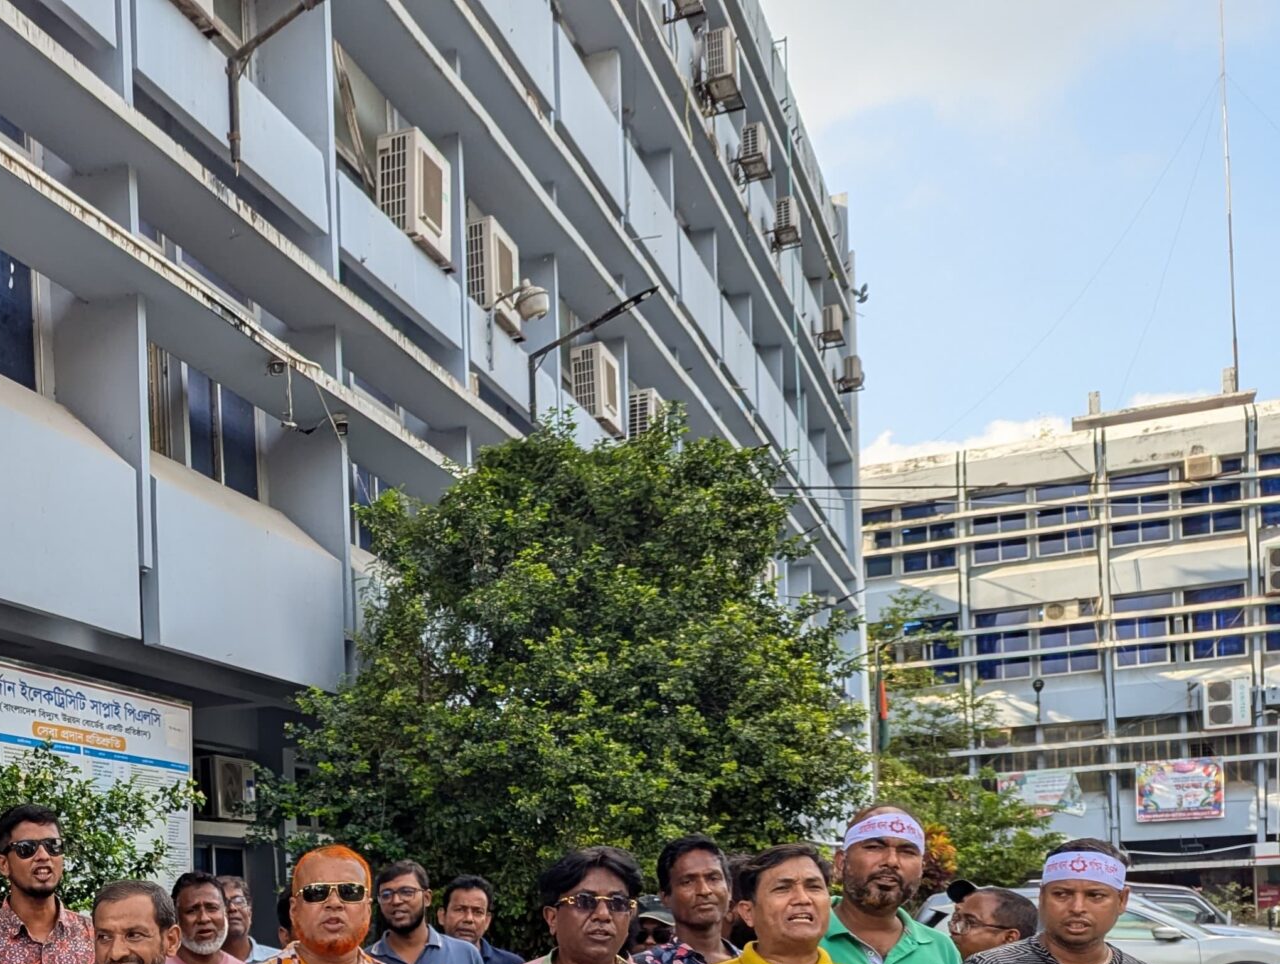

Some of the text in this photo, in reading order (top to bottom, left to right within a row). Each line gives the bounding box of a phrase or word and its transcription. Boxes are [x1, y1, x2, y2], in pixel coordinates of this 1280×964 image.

[19, 679, 87, 711] ইলেকট্রিসিটি
[90, 699, 122, 720] সাপ্লাই
[124, 703, 161, 727] পিএলসি
